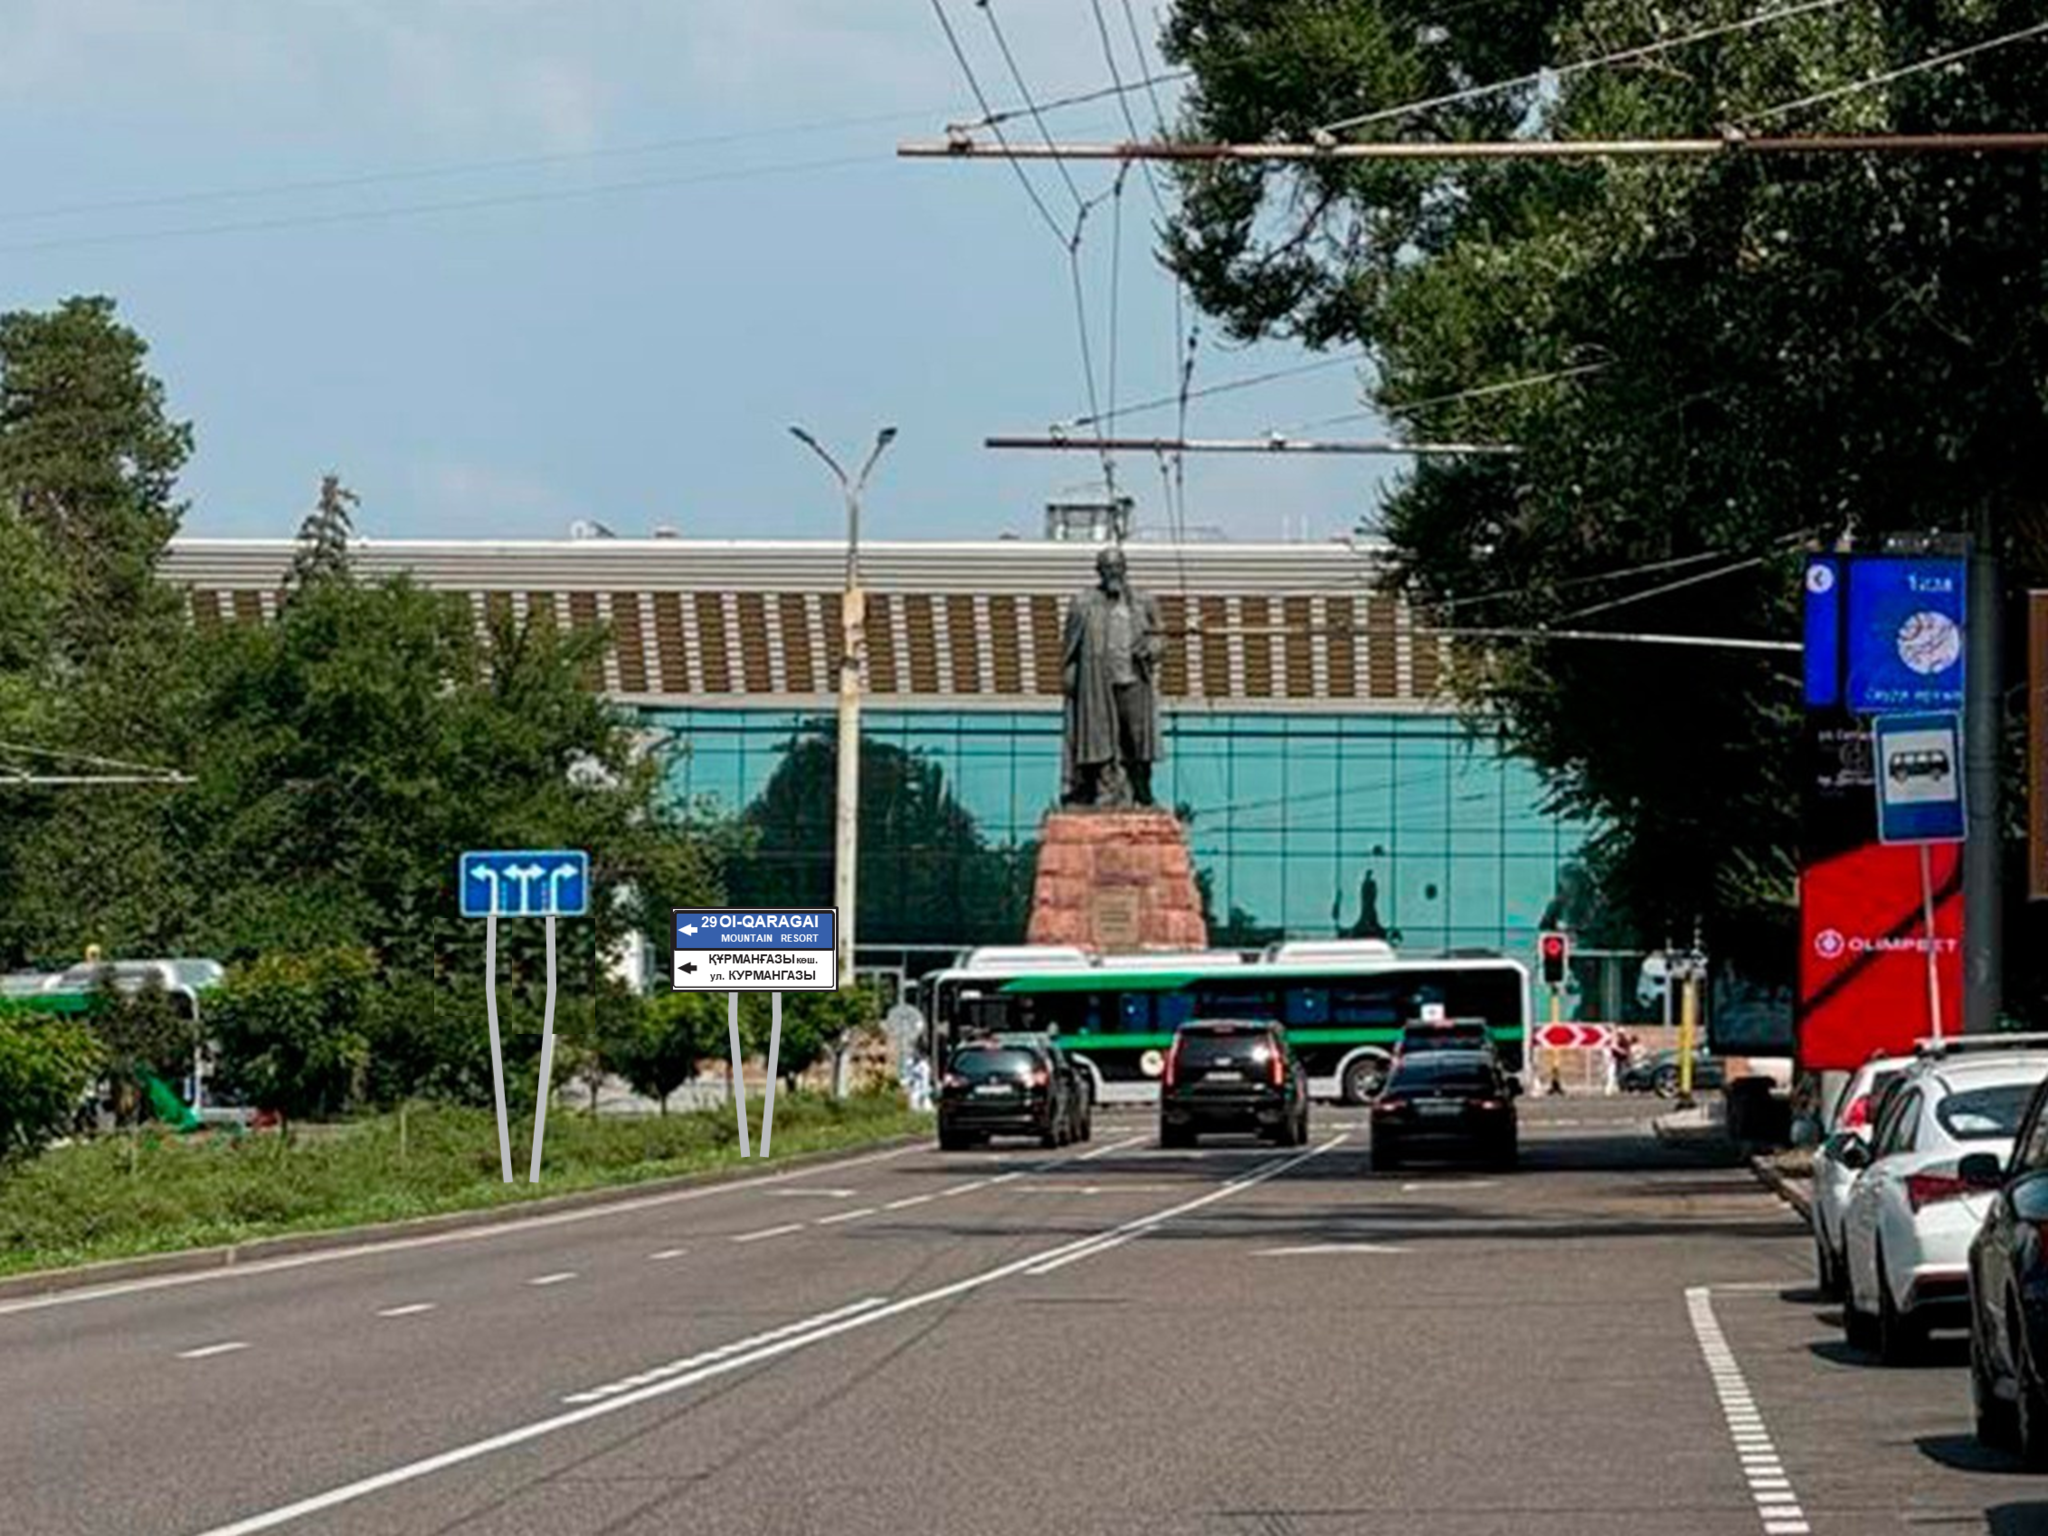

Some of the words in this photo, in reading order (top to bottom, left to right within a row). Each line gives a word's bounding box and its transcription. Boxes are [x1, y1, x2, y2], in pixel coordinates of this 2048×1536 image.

[701, 915, 718, 928] 29
[719, 915, 819, 929] OI-QARAGAI
[721, 934, 773, 943] MOUNTAIN
[780, 934, 819, 943] RESORT
[708, 954, 795, 966] ҚҰРМАНҒАЗЫ
[796, 957, 818, 965] көш.
[709, 973, 725, 983] ул.
[728, 971, 816, 981] КУРМАНГАЗЫ
